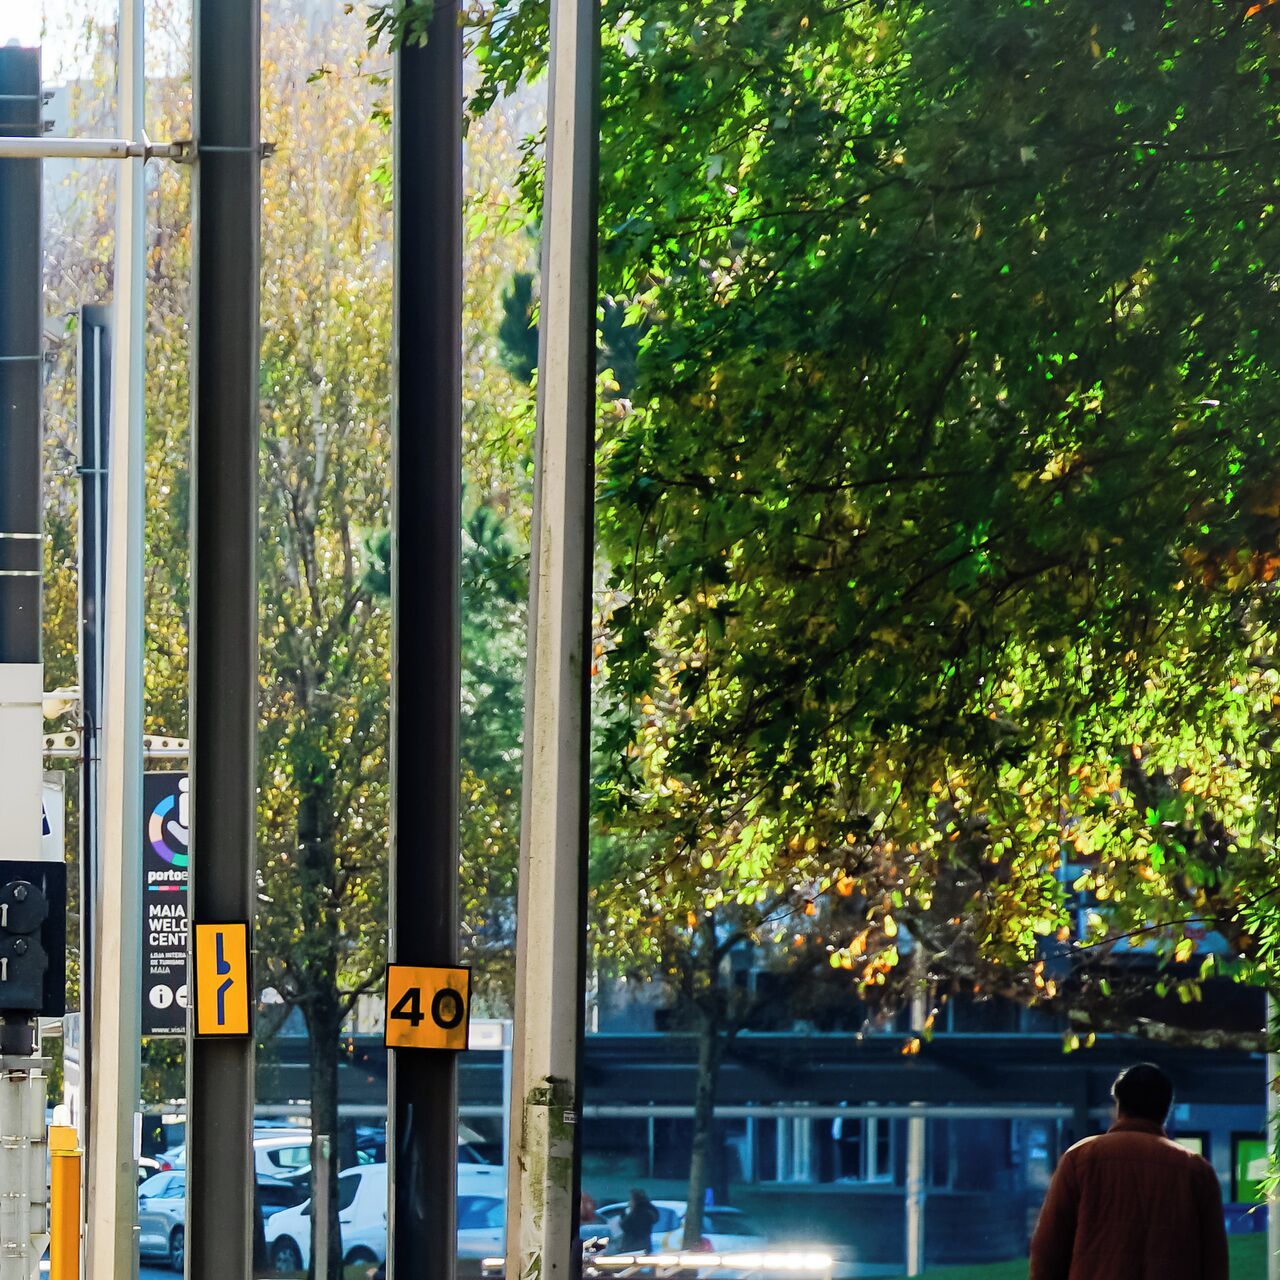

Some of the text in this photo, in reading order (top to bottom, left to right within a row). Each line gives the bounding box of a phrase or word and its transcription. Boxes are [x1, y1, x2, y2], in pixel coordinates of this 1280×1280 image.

[149, 904, 186, 918] MAIA
[148, 918, 188, 932] WELC
[149, 932, 188, 946] CENT
[150, 966, 171, 975] MAIA
[390, 987, 465, 1030] 40
